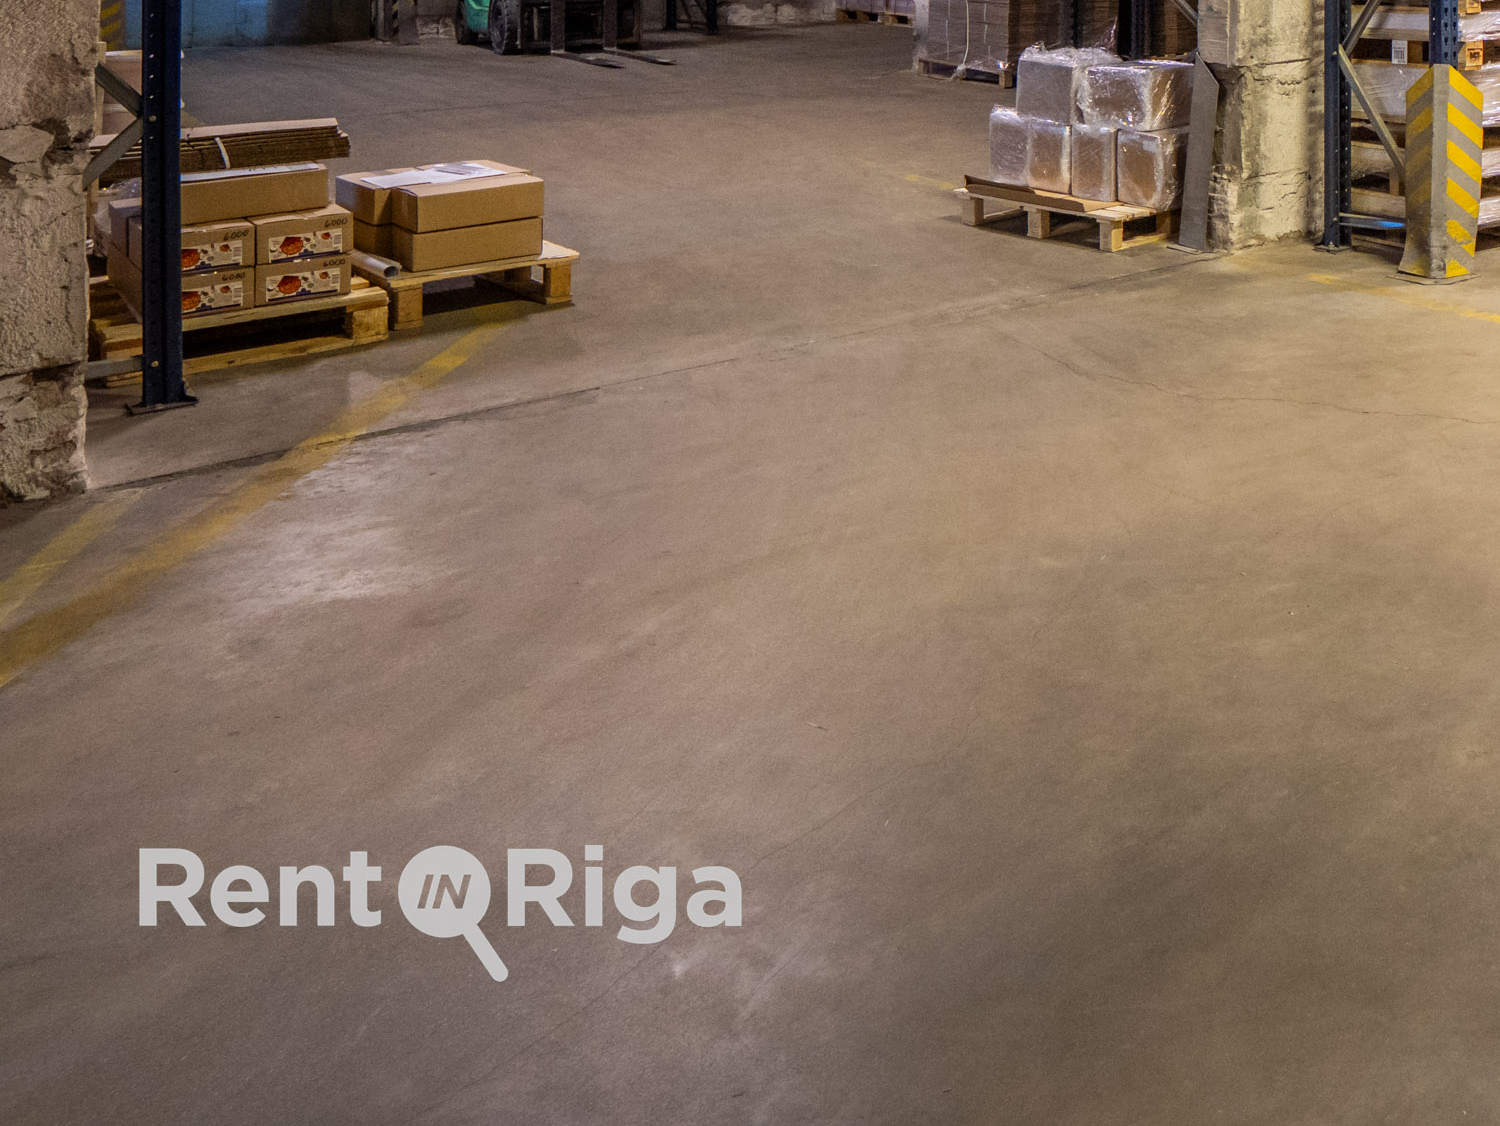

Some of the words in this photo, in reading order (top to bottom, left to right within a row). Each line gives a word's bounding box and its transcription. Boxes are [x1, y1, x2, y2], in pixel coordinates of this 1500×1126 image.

[324, 217, 348, 228] 6000
[223, 229, 249, 241] 6000
[322, 258, 346, 267] 6000
